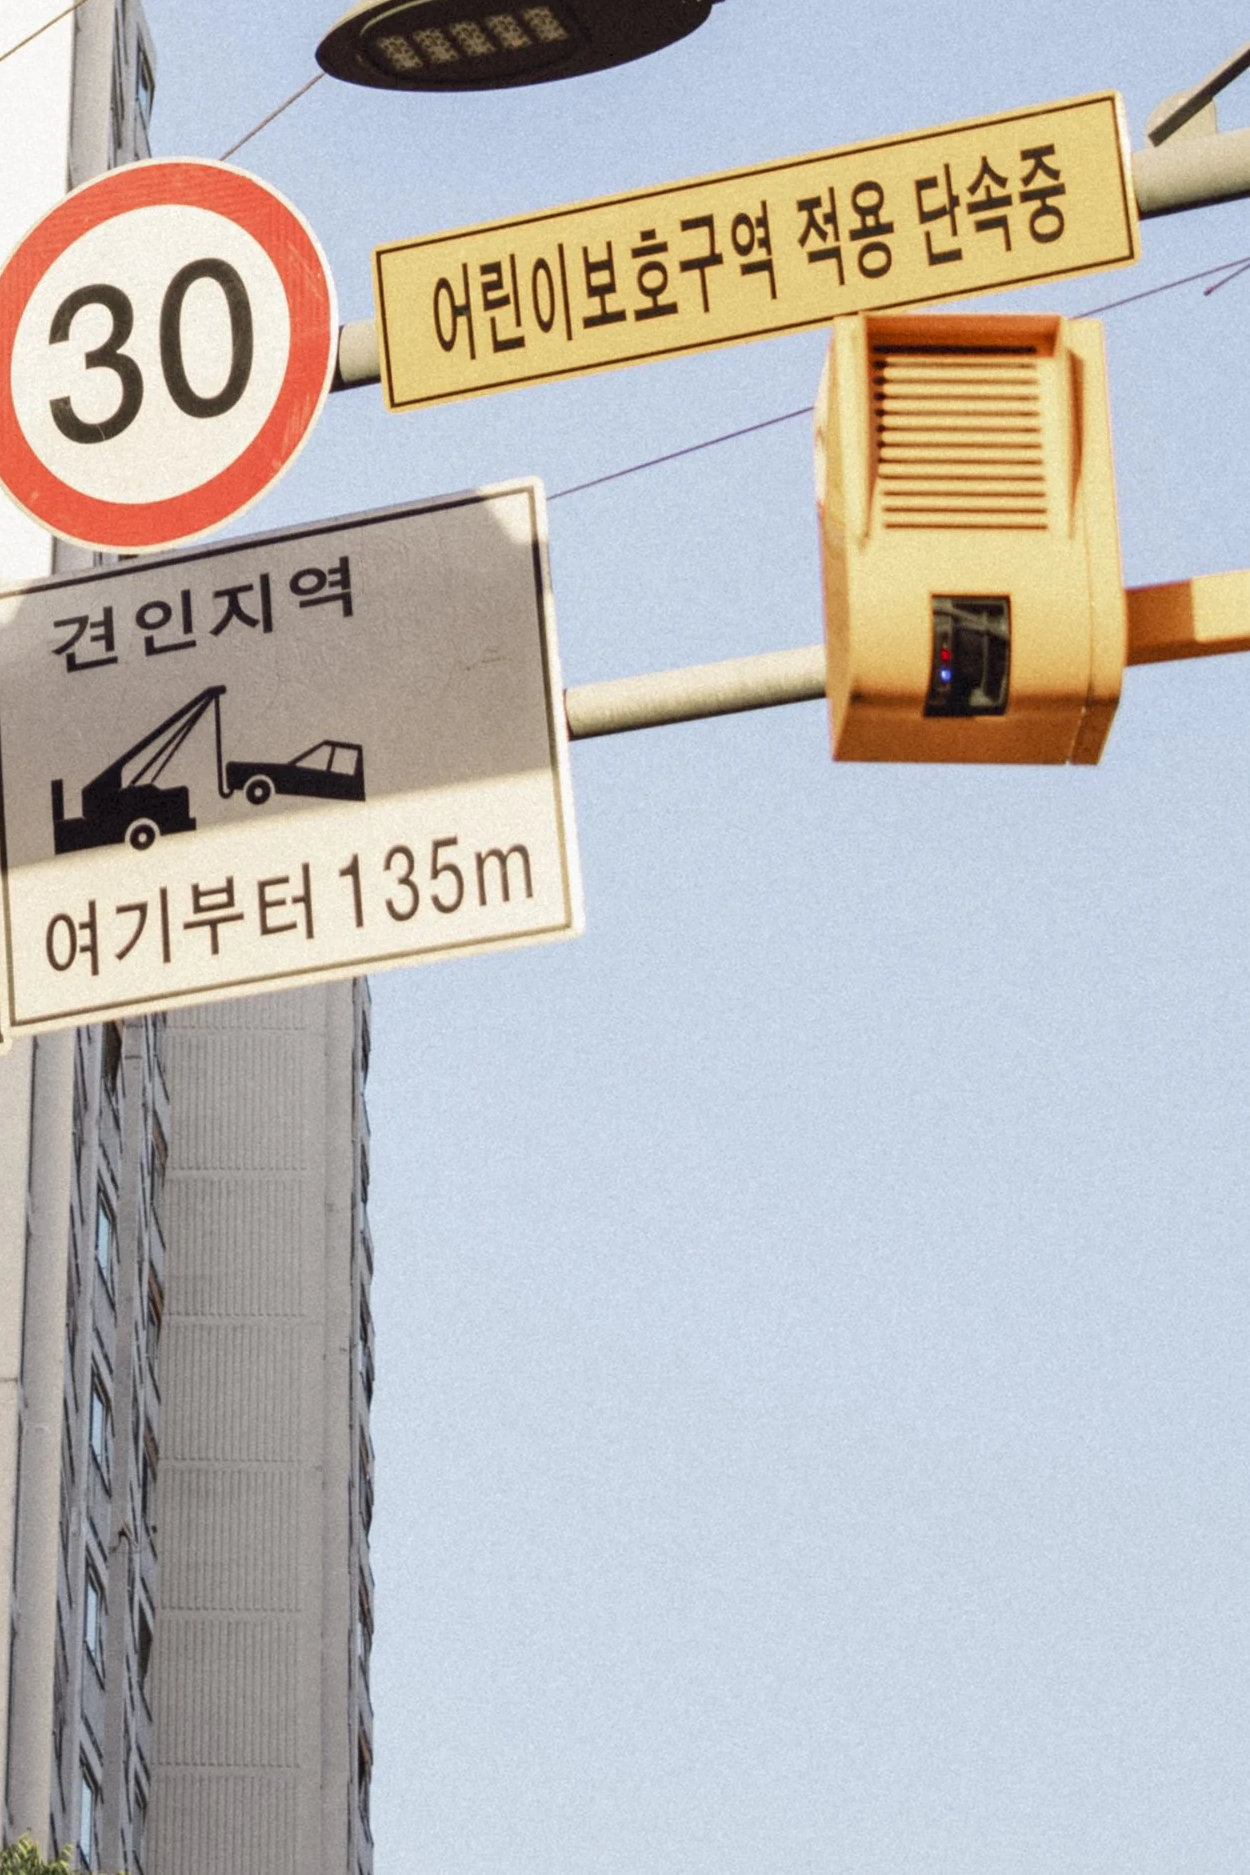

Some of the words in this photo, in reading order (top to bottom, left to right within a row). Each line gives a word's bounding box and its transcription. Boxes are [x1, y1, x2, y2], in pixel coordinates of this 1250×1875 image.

[432, 199, 778, 361] 어린이보호구역
[796, 179, 896, 287] 적용
[914, 143, 1067, 267] 단속중
[49, 257, 254, 445] 30
[51, 555, 354, 673] 견인지역
[45, 861, 316, 977] 여기부터
[338, 834, 534, 929] 135m
